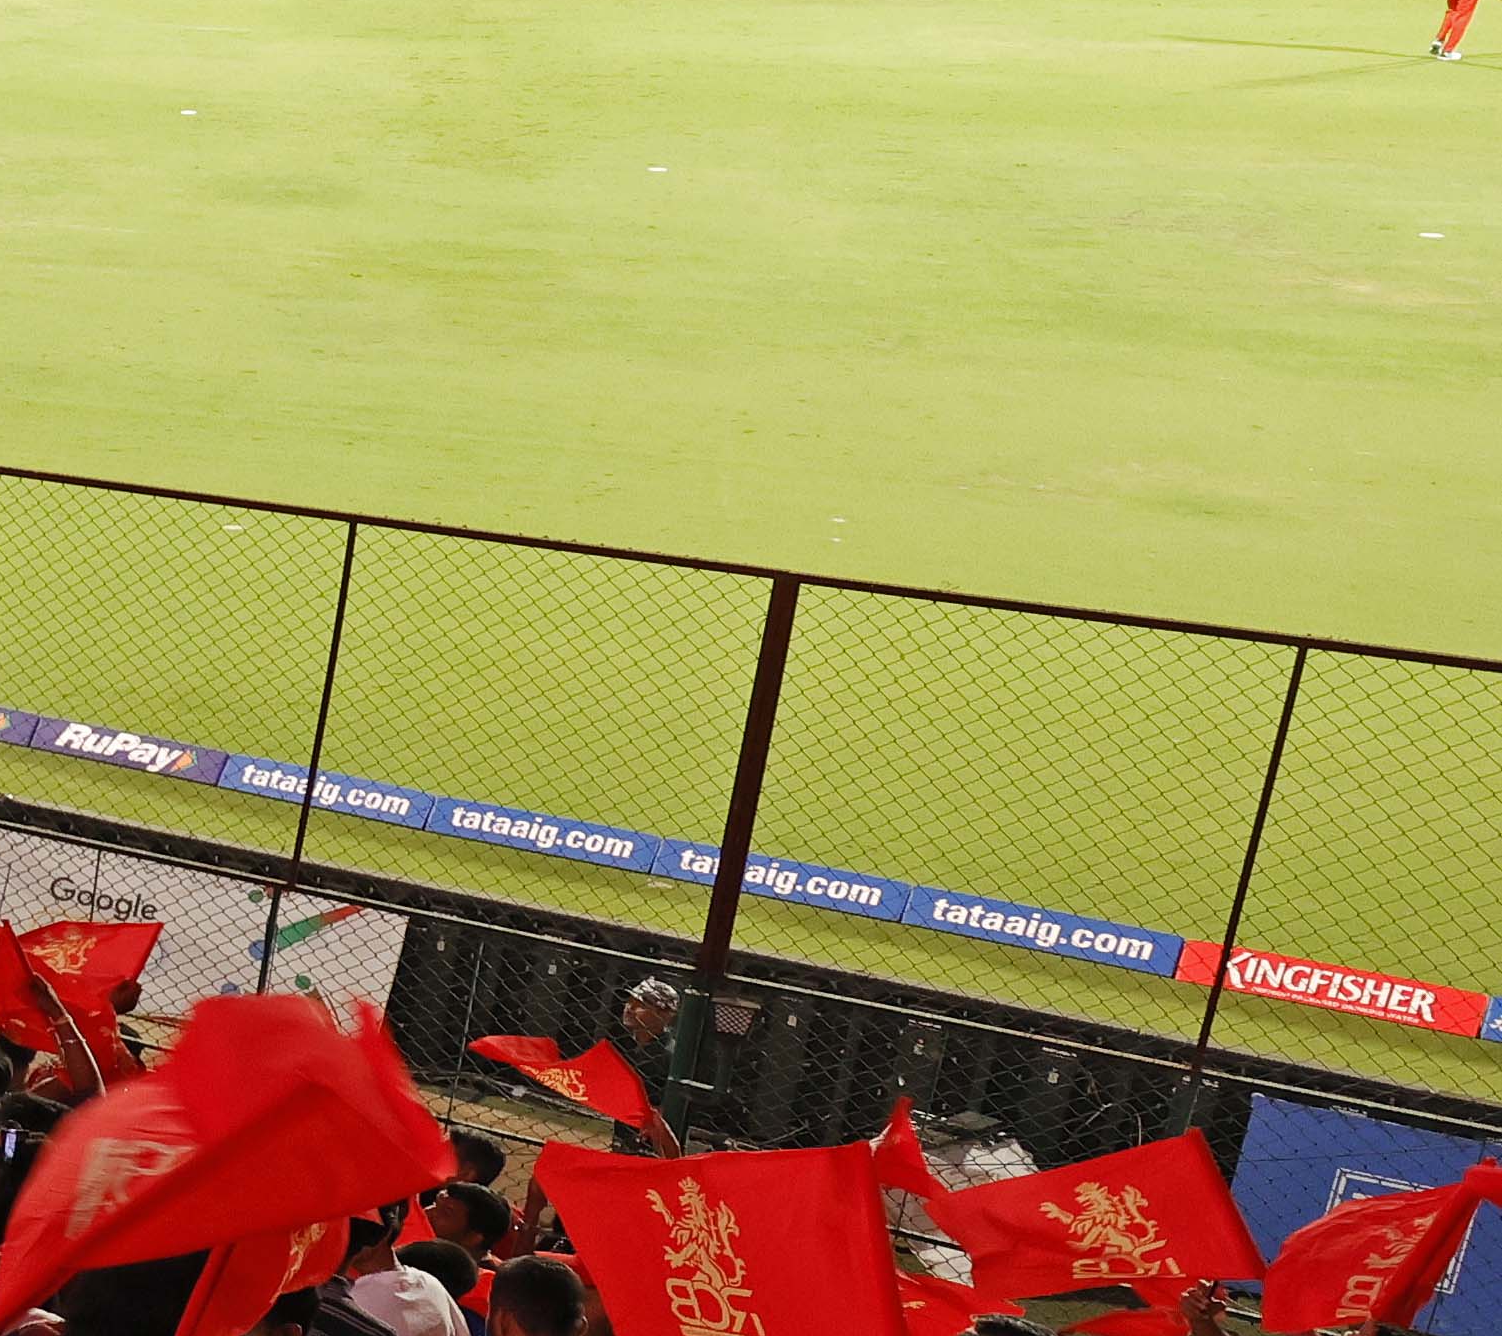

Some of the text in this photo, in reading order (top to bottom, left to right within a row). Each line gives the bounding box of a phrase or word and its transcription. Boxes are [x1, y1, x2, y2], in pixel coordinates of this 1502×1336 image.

[54, 722, 180, 773] RuPay
[451, 803, 634, 860] tataaig.com
[50, 876, 159, 922] Google
[932, 896, 1155, 964] tataaig.com
[1226, 951, 1437, 1023] KINGFISHER
